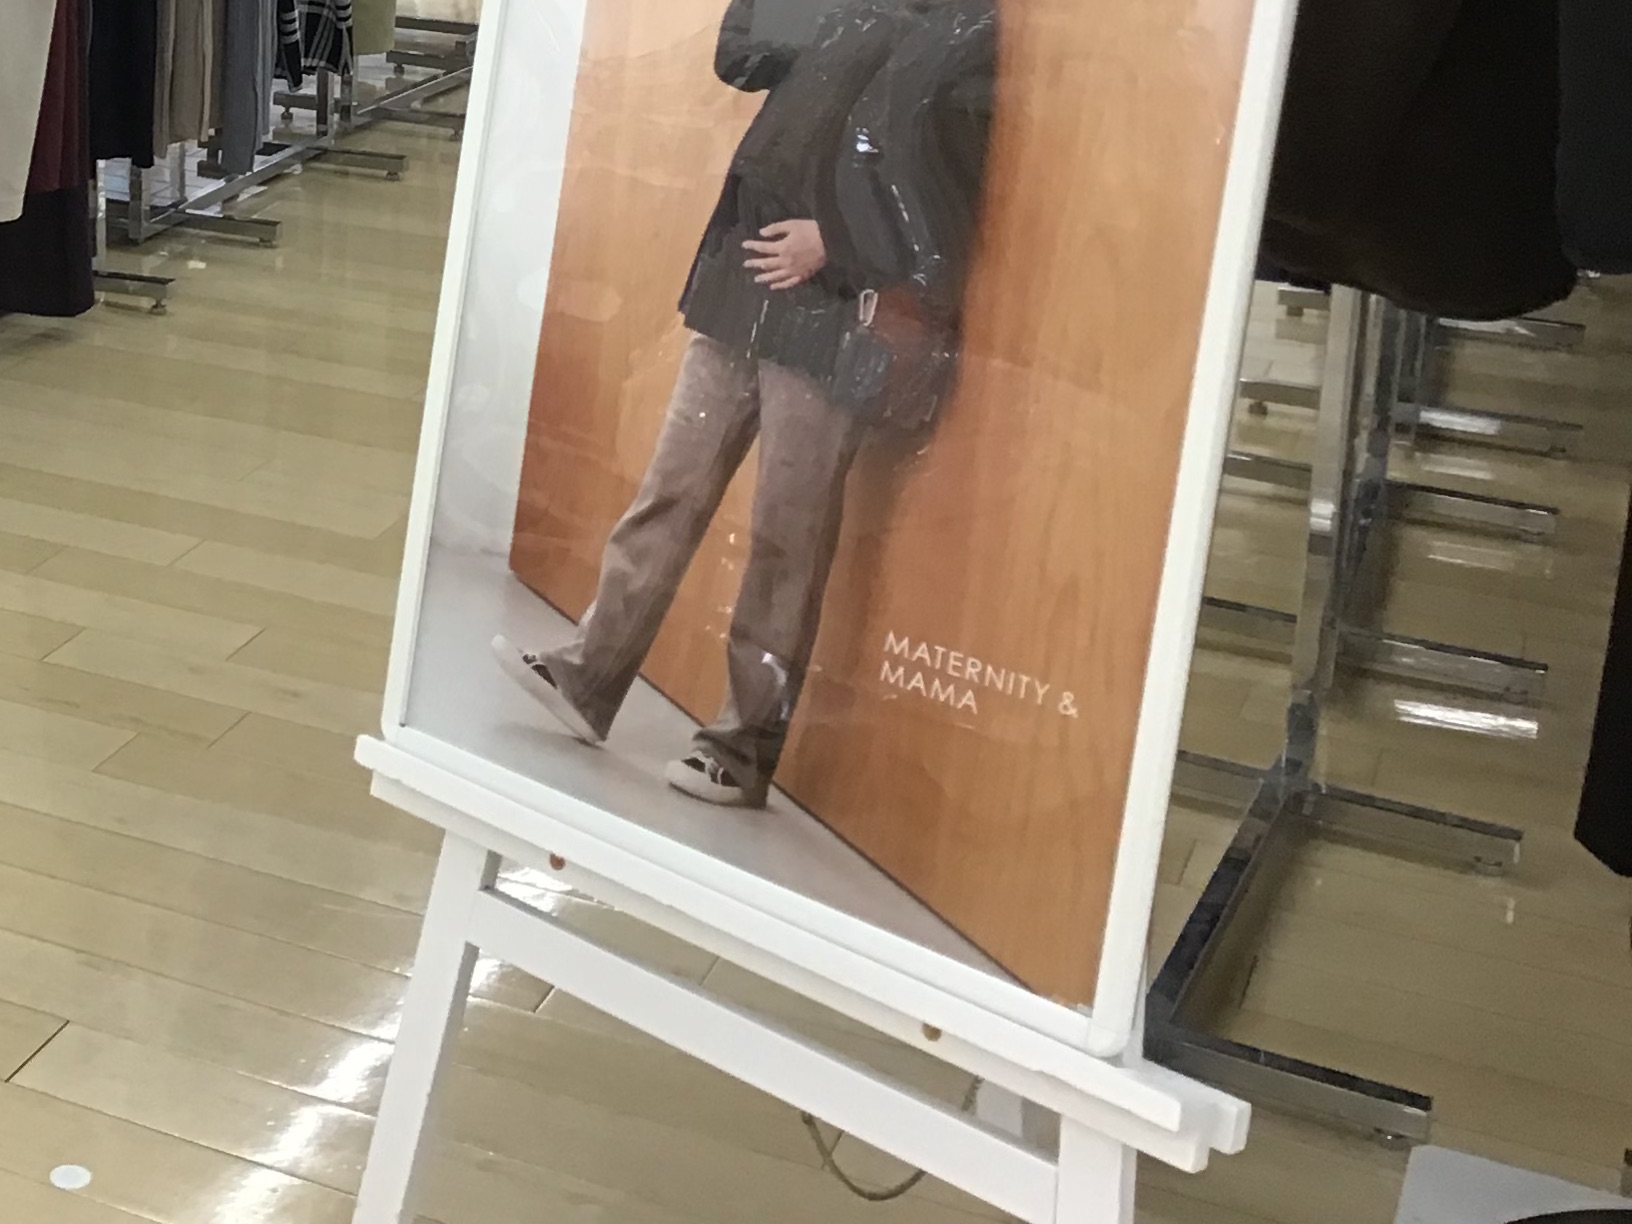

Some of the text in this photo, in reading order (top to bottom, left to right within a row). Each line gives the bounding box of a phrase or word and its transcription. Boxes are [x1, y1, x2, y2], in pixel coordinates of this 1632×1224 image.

[879, 660, 978, 715] MAMA
[883, 630, 1079, 719] MATERNITY &
